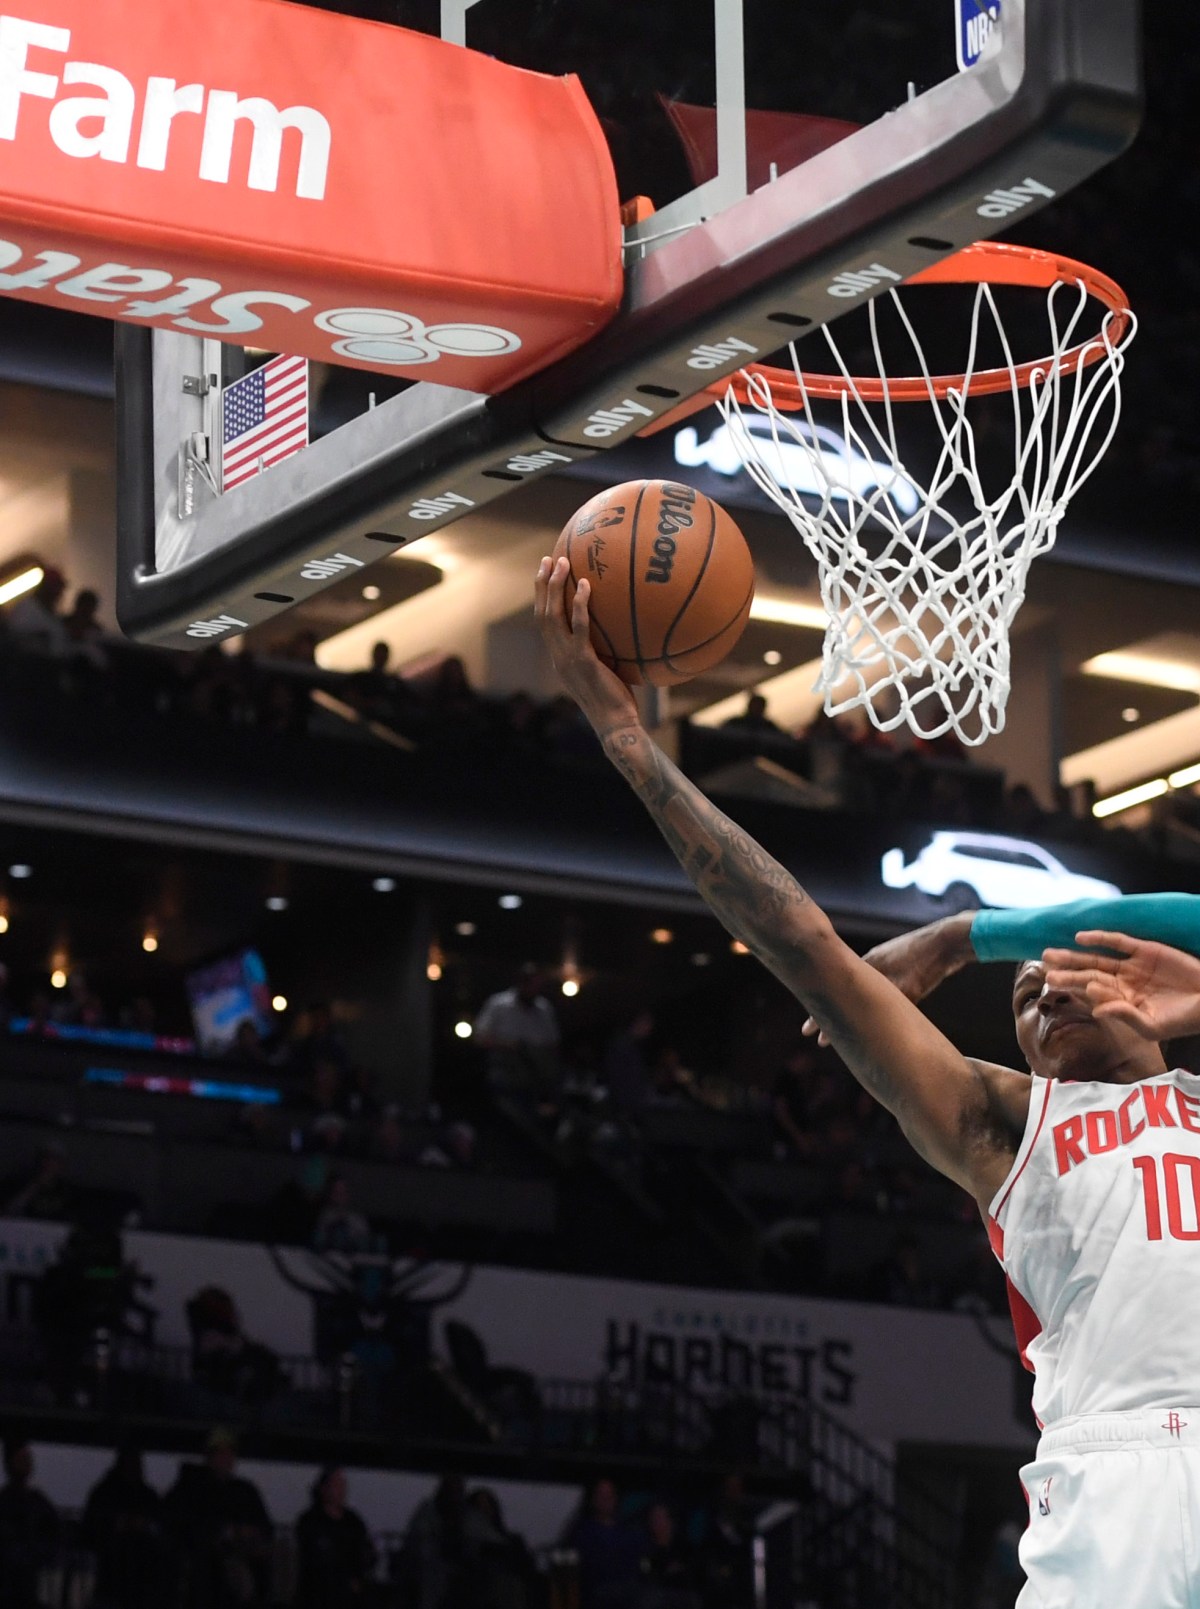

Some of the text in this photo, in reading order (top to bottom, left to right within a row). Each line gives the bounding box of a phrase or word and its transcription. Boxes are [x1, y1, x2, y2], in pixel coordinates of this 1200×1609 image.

[0, 15, 331, 200] Farm
[977, 178, 1056, 218] ally
[0, 240, 311, 334] Stat
[826, 263, 901, 298] ally
[686, 336, 759, 370] ally
[582, 398, 654, 438] ally
[506, 450, 572, 472] ally
[408, 491, 475, 520] ally
[300, 552, 365, 580] ally
[186, 614, 249, 638] ally
[606, 1318, 855, 1405] HORNETS
